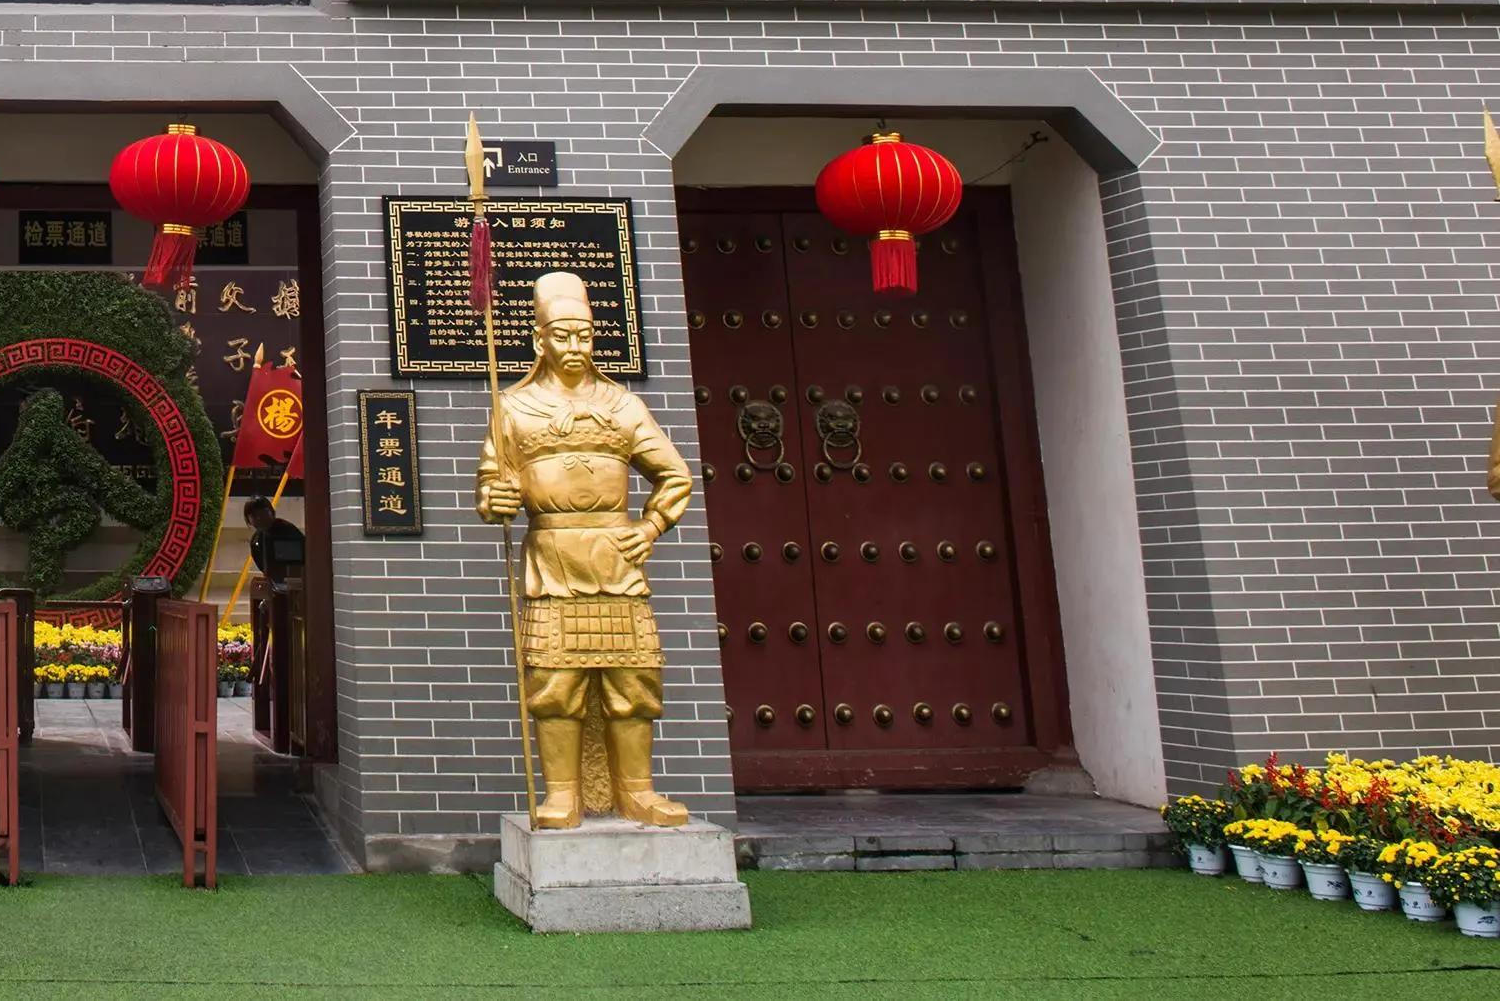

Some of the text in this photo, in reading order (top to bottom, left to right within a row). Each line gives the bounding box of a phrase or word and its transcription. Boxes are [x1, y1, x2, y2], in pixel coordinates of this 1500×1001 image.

[517, 152, 538, 162] 入口
[507, 164, 550, 174] Entrance
[454, 217, 566, 229] 游入园须知
[23, 220, 108, 249] 检票通道
[263, 396, 299, 433] 楊
[374, 410, 407, 516] 年票通道
